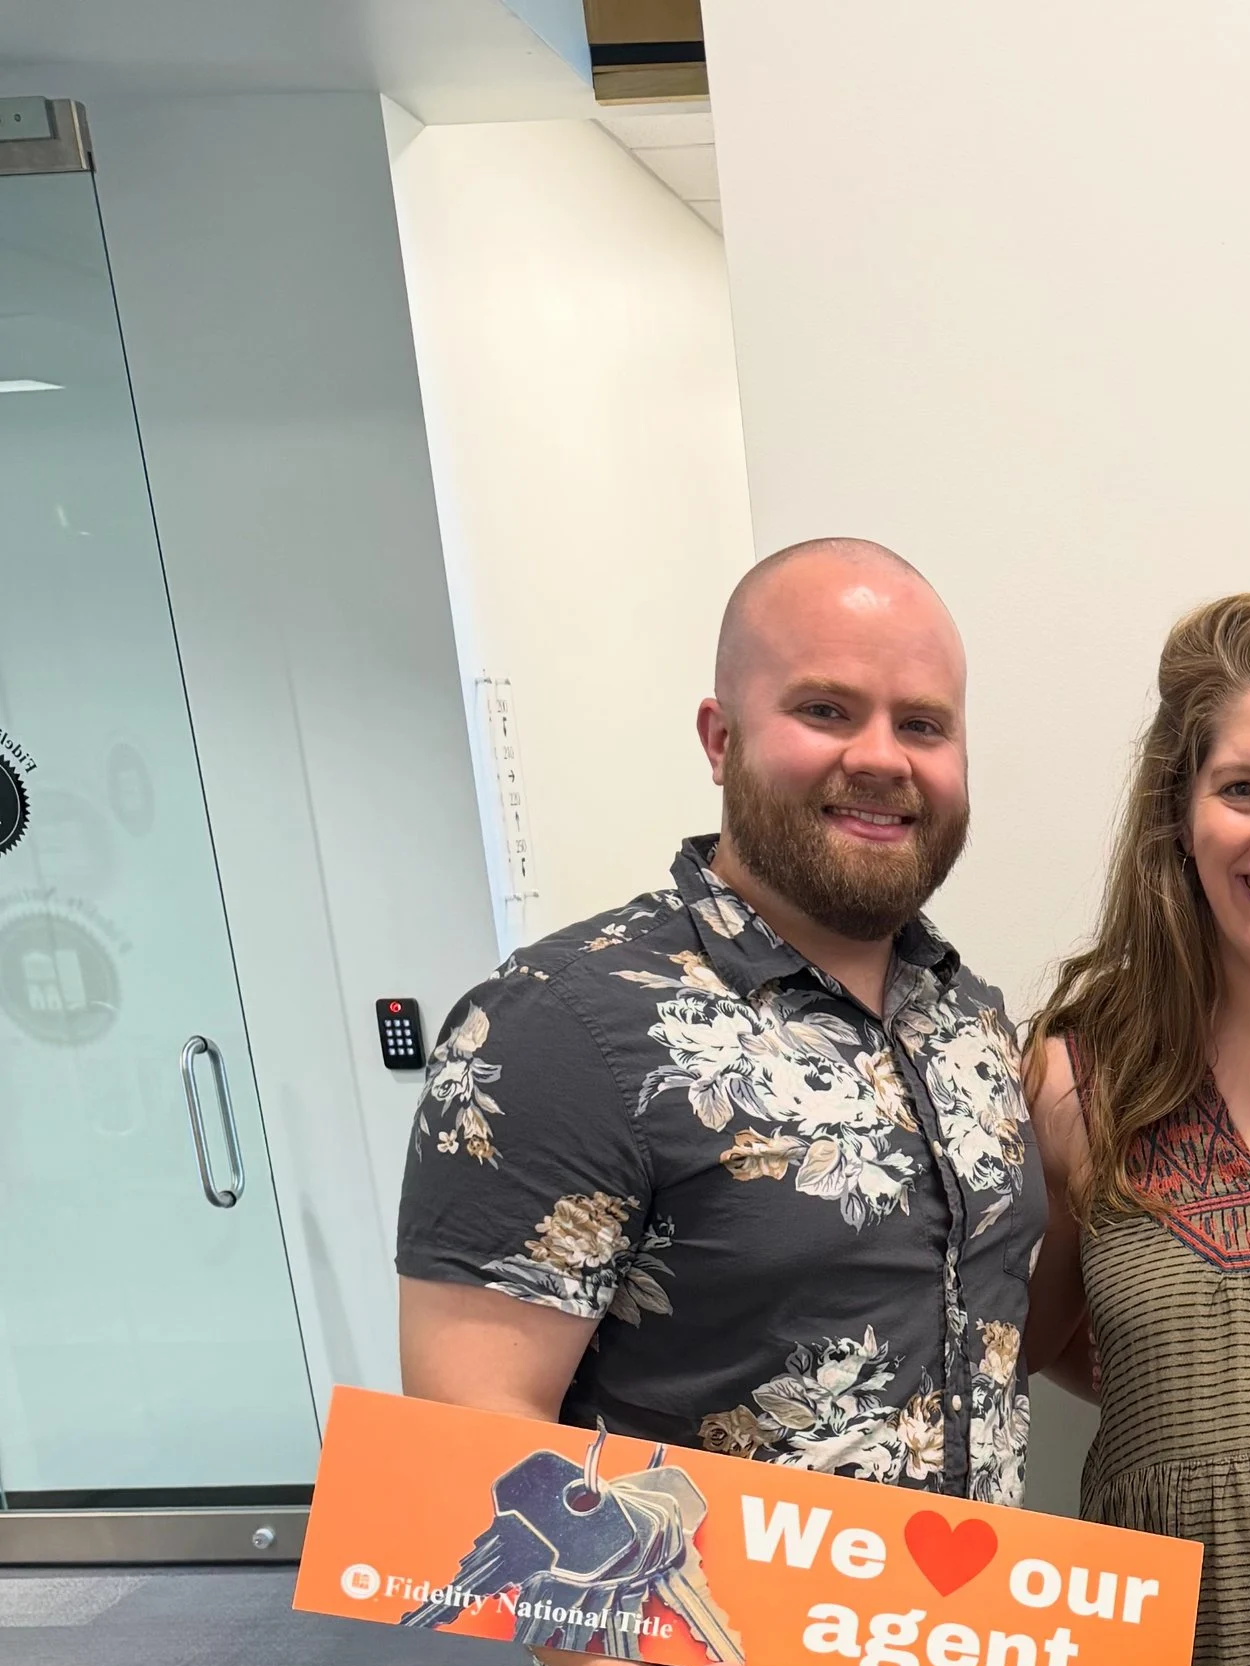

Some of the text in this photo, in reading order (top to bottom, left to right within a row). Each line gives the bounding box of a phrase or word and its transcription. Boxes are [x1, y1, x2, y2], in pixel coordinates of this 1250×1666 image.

[383, 1574, 674, 1639] Fidelity National Title
[741, 1494, 1159, 1624] We our
